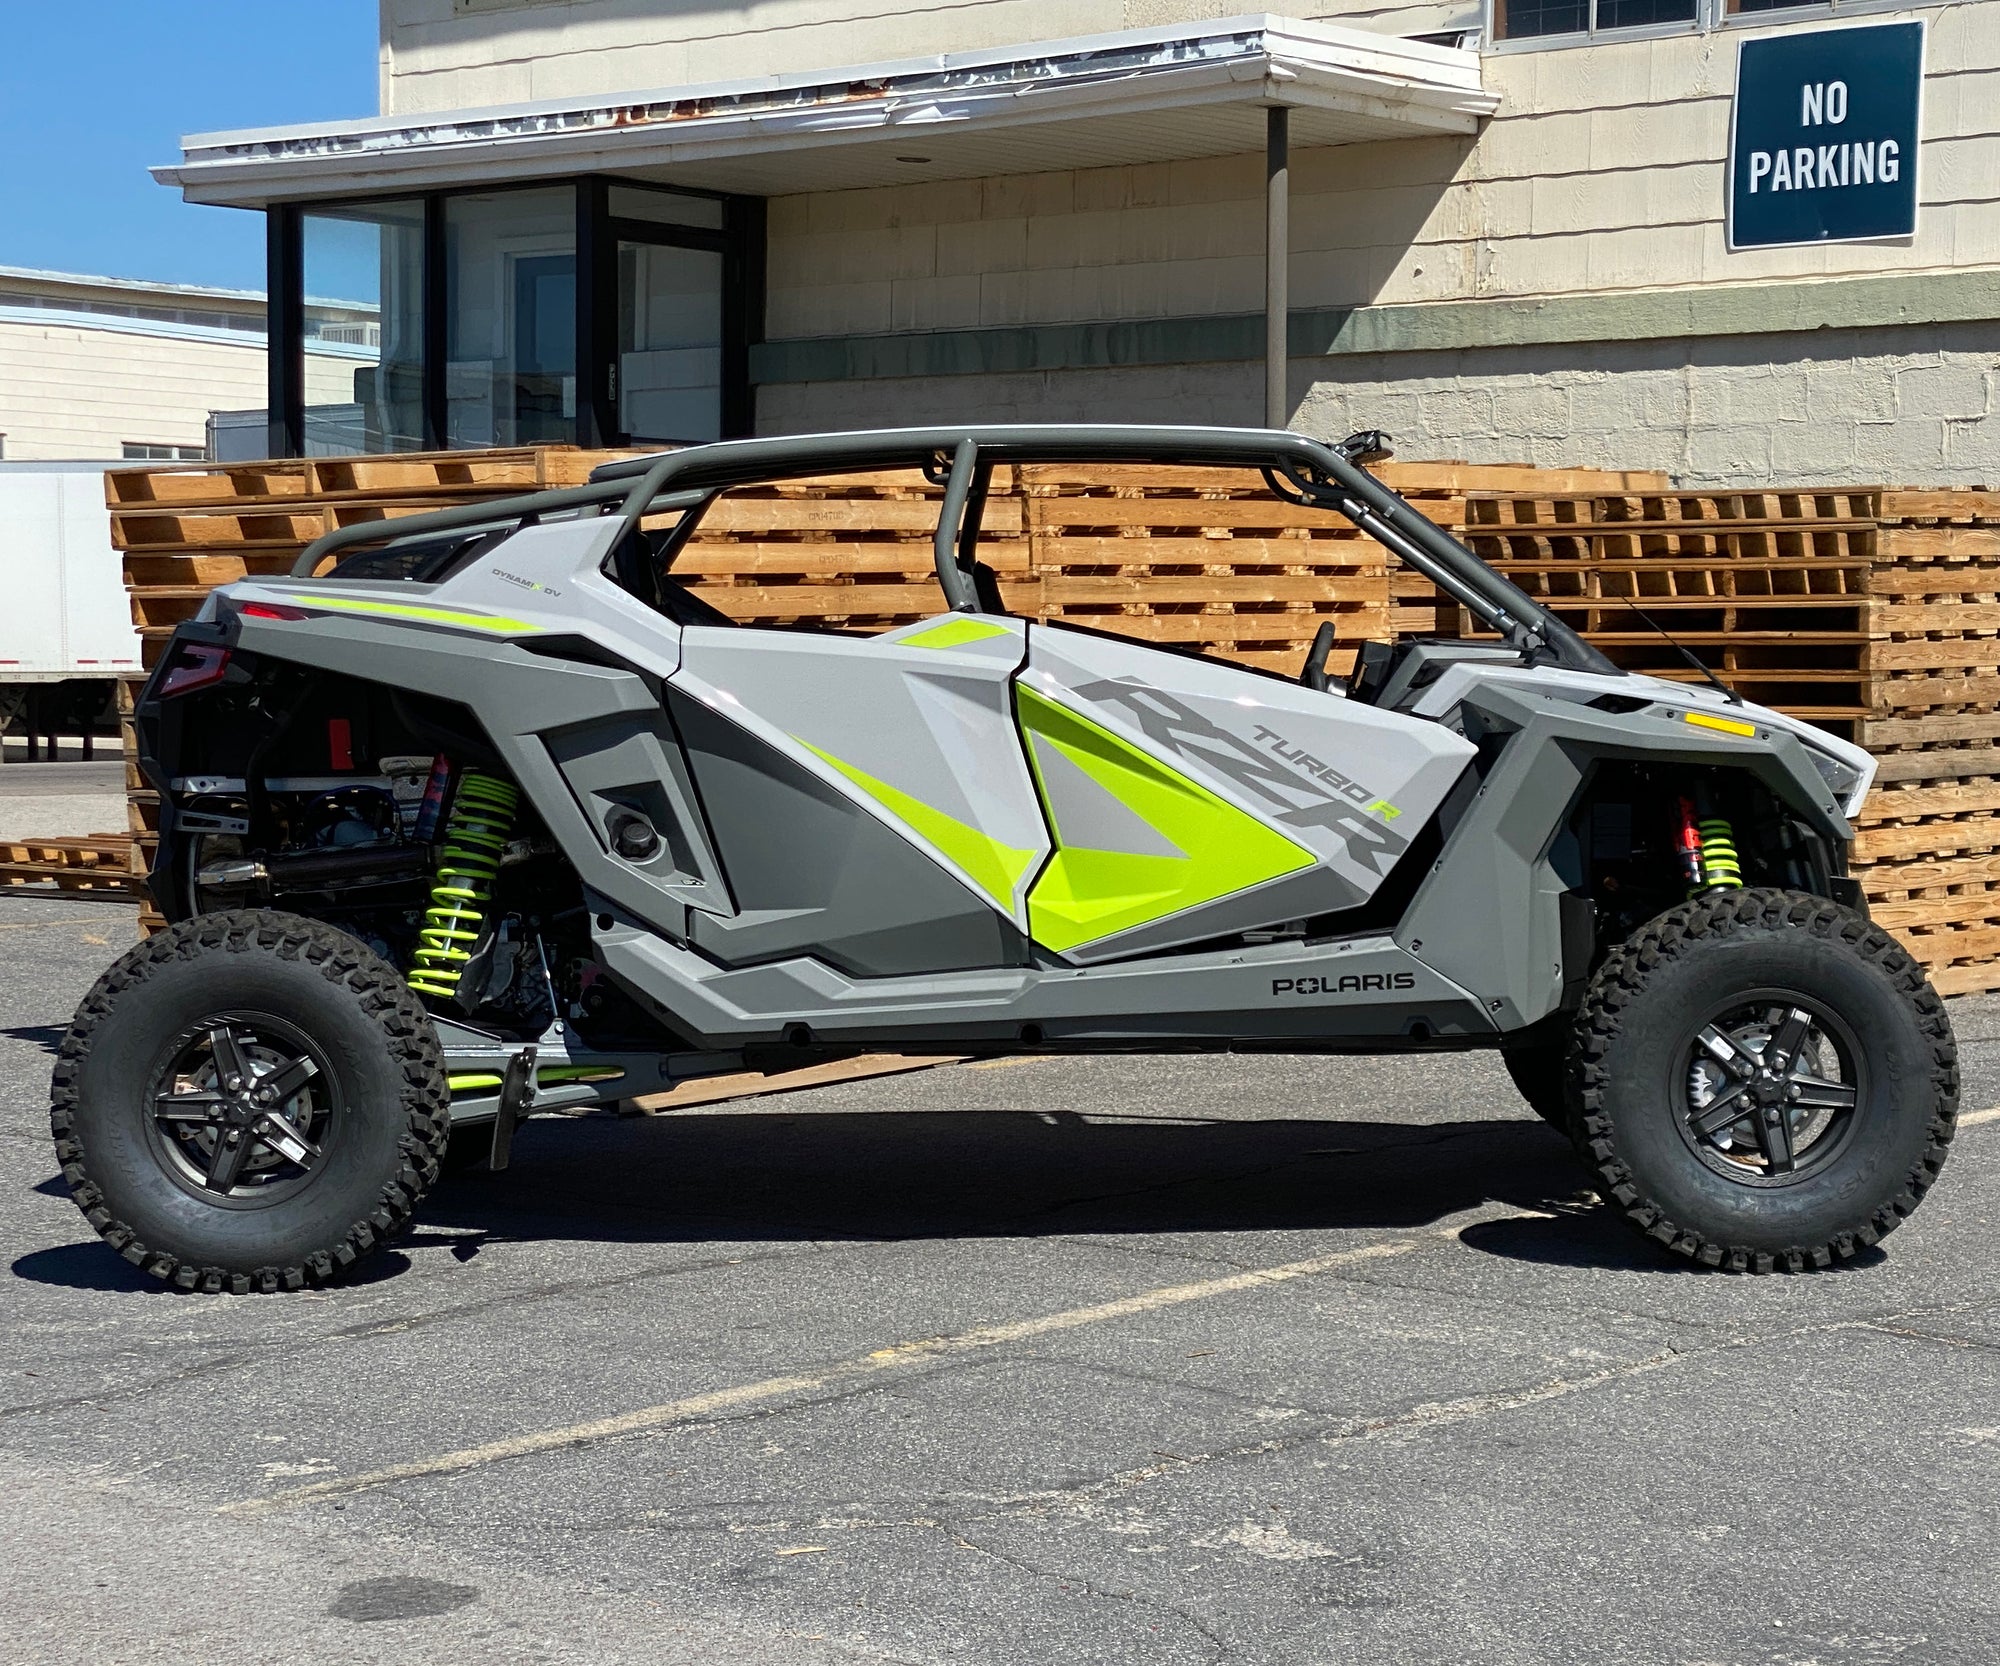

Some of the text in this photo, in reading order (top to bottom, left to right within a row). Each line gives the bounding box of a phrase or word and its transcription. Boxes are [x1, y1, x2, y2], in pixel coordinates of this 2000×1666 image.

[1801, 80, 1848, 127] NO
[1750, 139, 1900, 194] PARKING
[544, 587, 562, 597] DV
[1062, 675, 1409, 878] RZR
[1252, 724, 1402, 823] TURBO R
[1272, 972, 1416, 996] POLARIS
